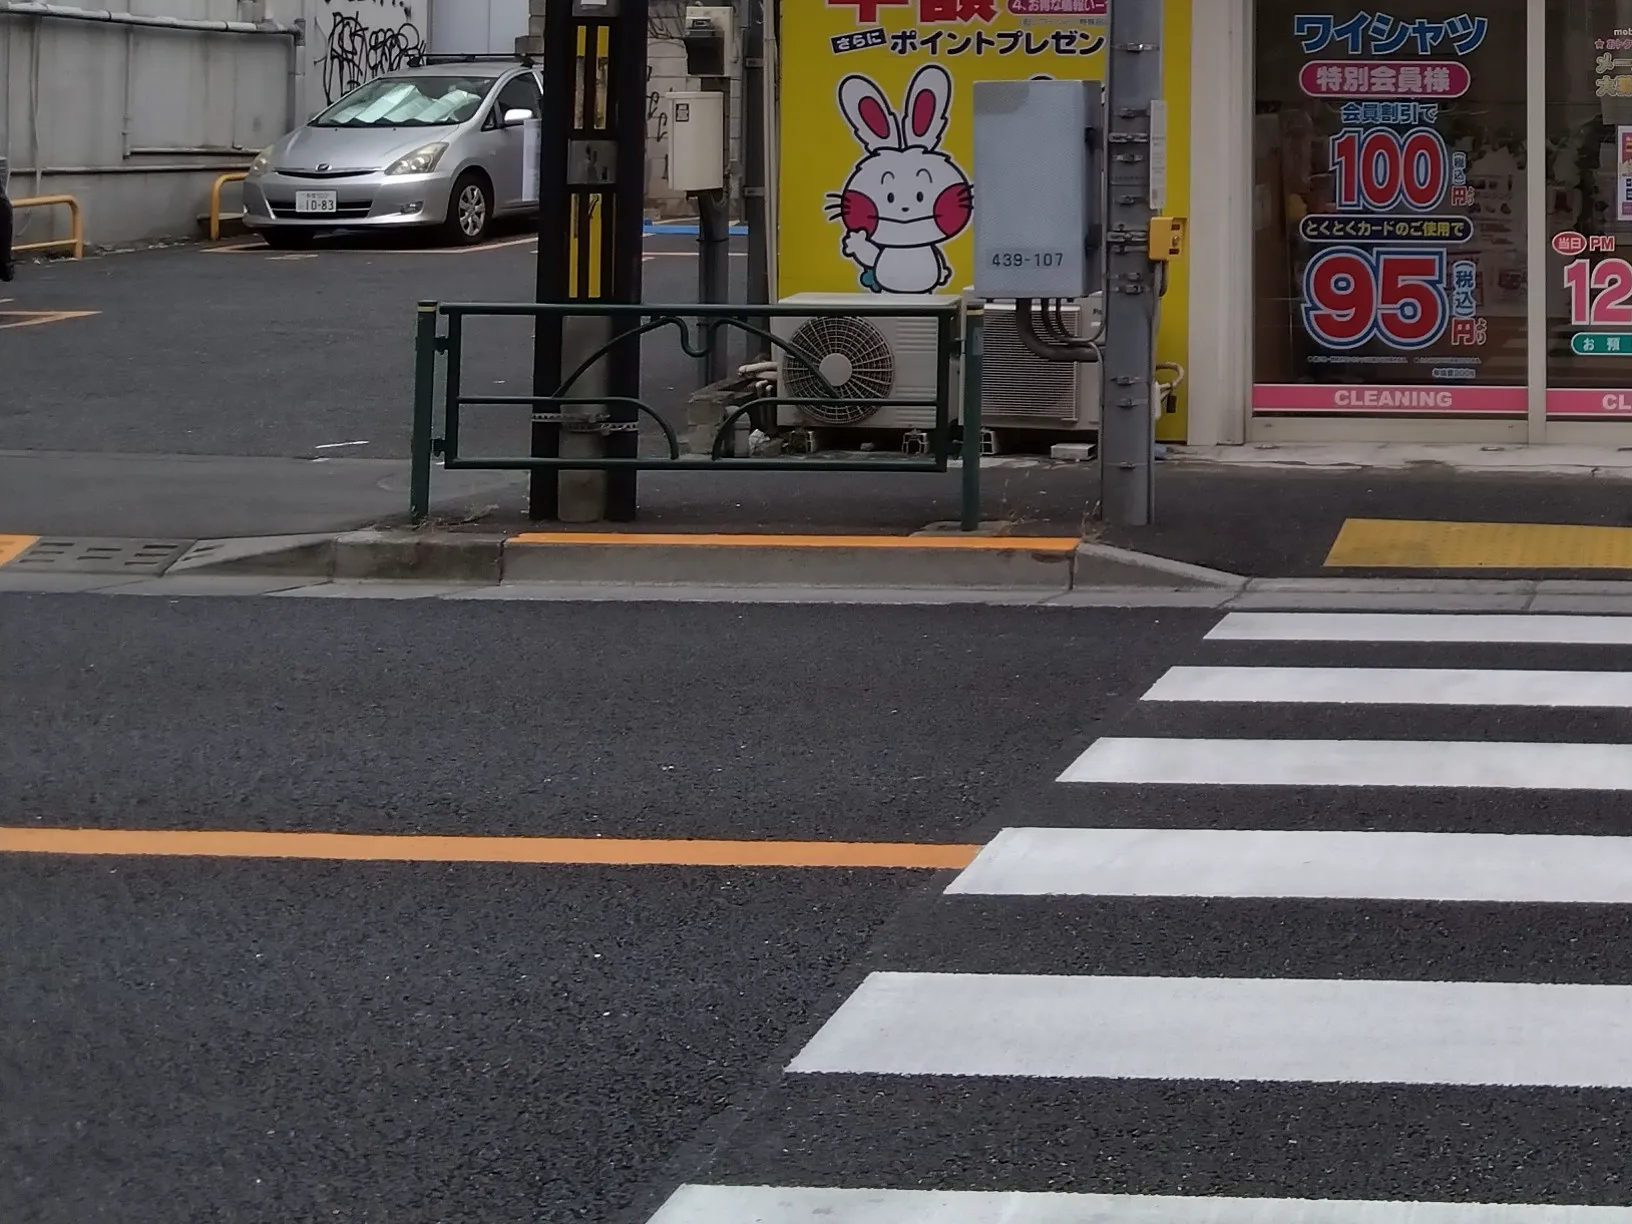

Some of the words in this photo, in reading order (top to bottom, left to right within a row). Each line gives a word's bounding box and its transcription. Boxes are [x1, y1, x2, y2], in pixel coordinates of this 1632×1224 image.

[836, 31, 884, 48] さらに
[1294, 11, 1488, 55] ワイシャツ
[1316, 66, 1450, 93] 特別会員様
[1341, 102, 1439, 124] 会員割引で
[1329, 127, 1450, 210] 100
[1304, 220, 1466, 238] とくとくカードのご使用で
[1558, 238, 1582, 250] 当日
[1589, 236, 1615, 252] PM
[992, 252, 1065, 268] 439-107
[1301, 245, 1450, 350] 95
[1451, 318, 1476, 345] 円
[1334, 390, 1452, 407] CLEANING
